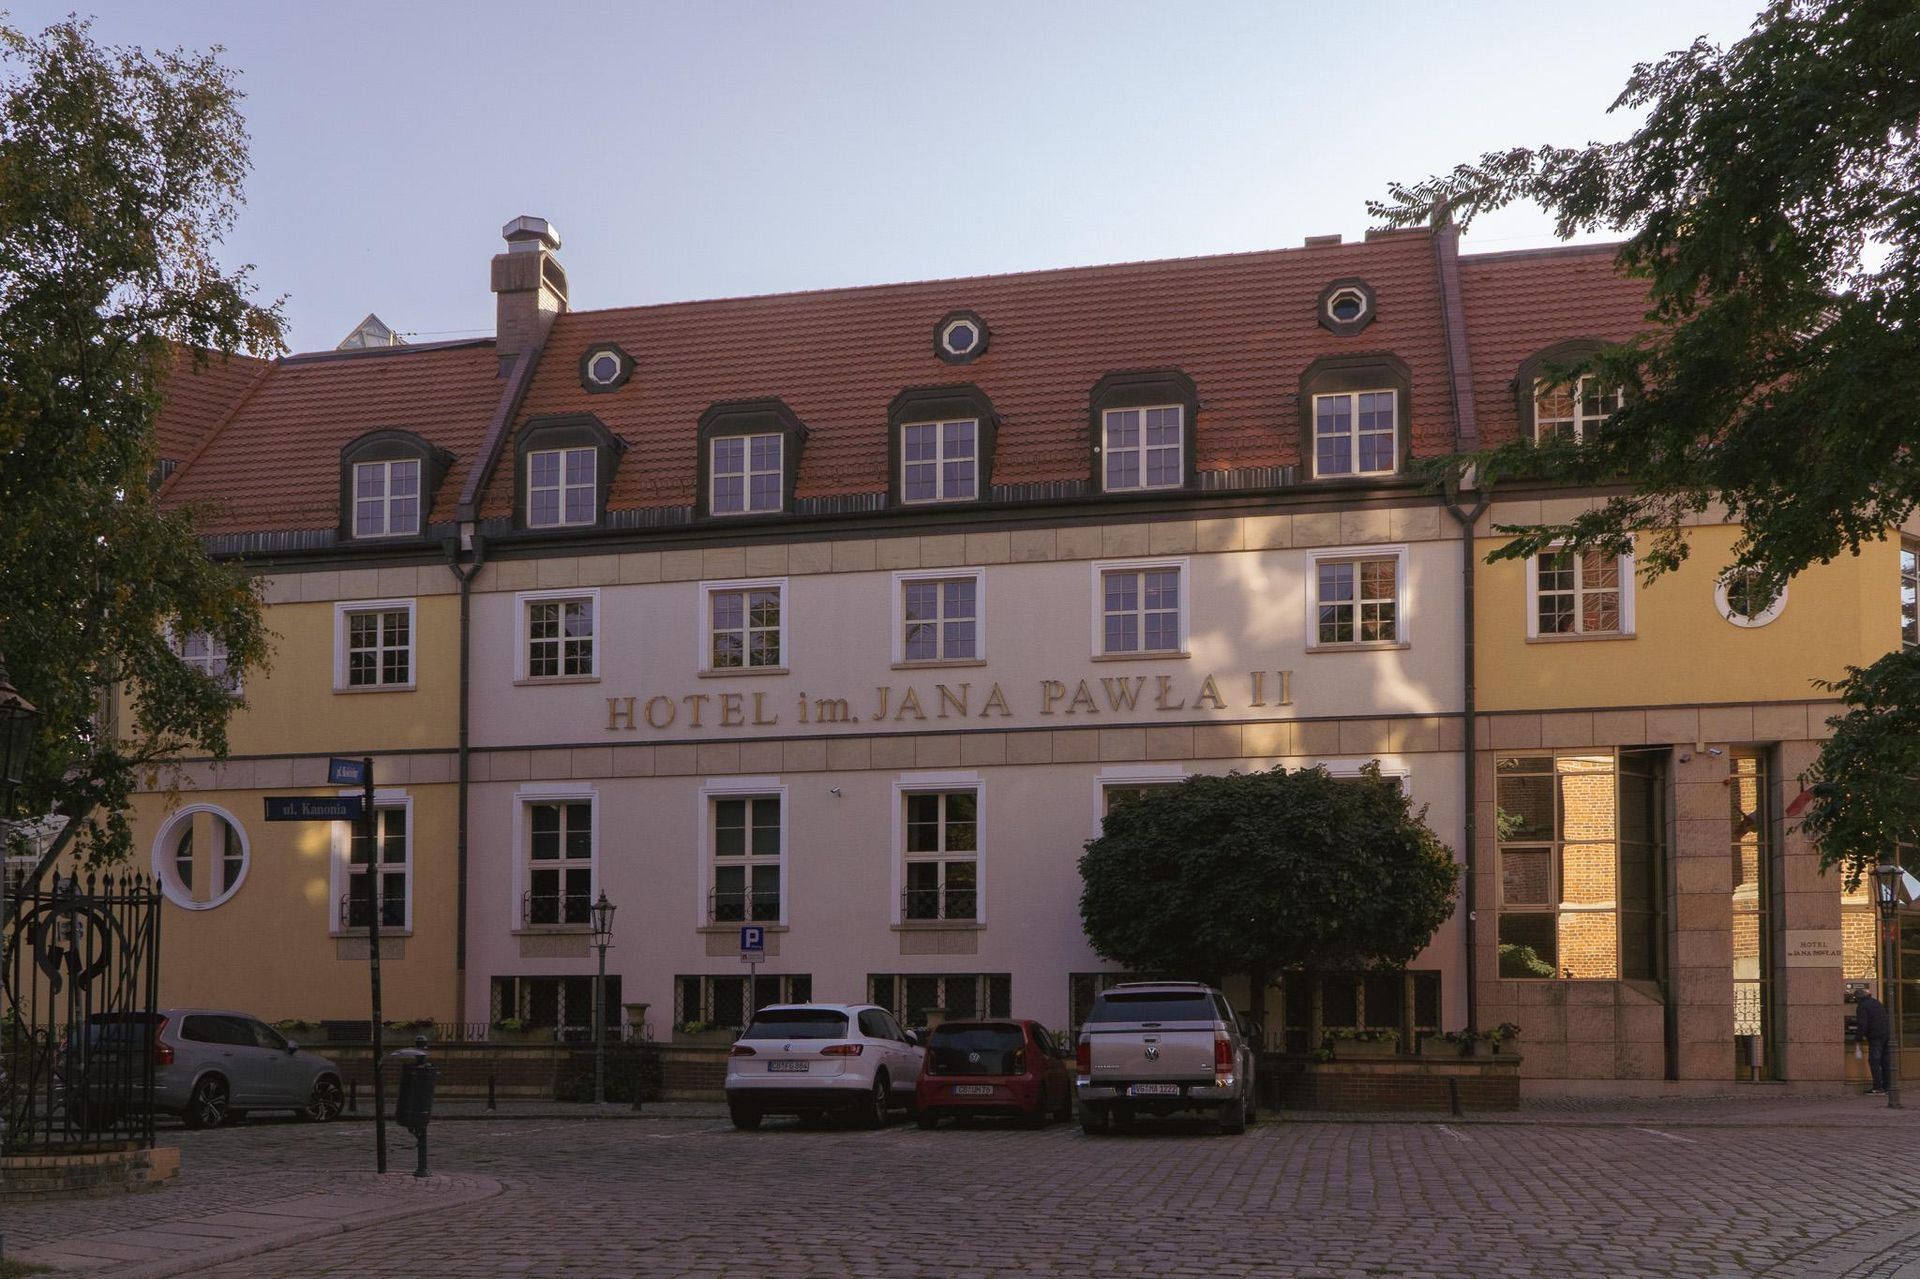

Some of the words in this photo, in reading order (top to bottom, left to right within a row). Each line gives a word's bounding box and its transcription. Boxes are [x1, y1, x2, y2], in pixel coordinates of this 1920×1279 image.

[605, 692, 778, 730] HOTEL
[797, 691, 860, 724] im.
[871, 681, 1013, 721] JANA
[1039, 673, 1228, 714] PAWŁA
[1249, 670, 1294, 708] II
[283, 804, 298, 816] ul.
[302, 803, 347, 815] Kanonia
[745, 928, 759, 948] P
